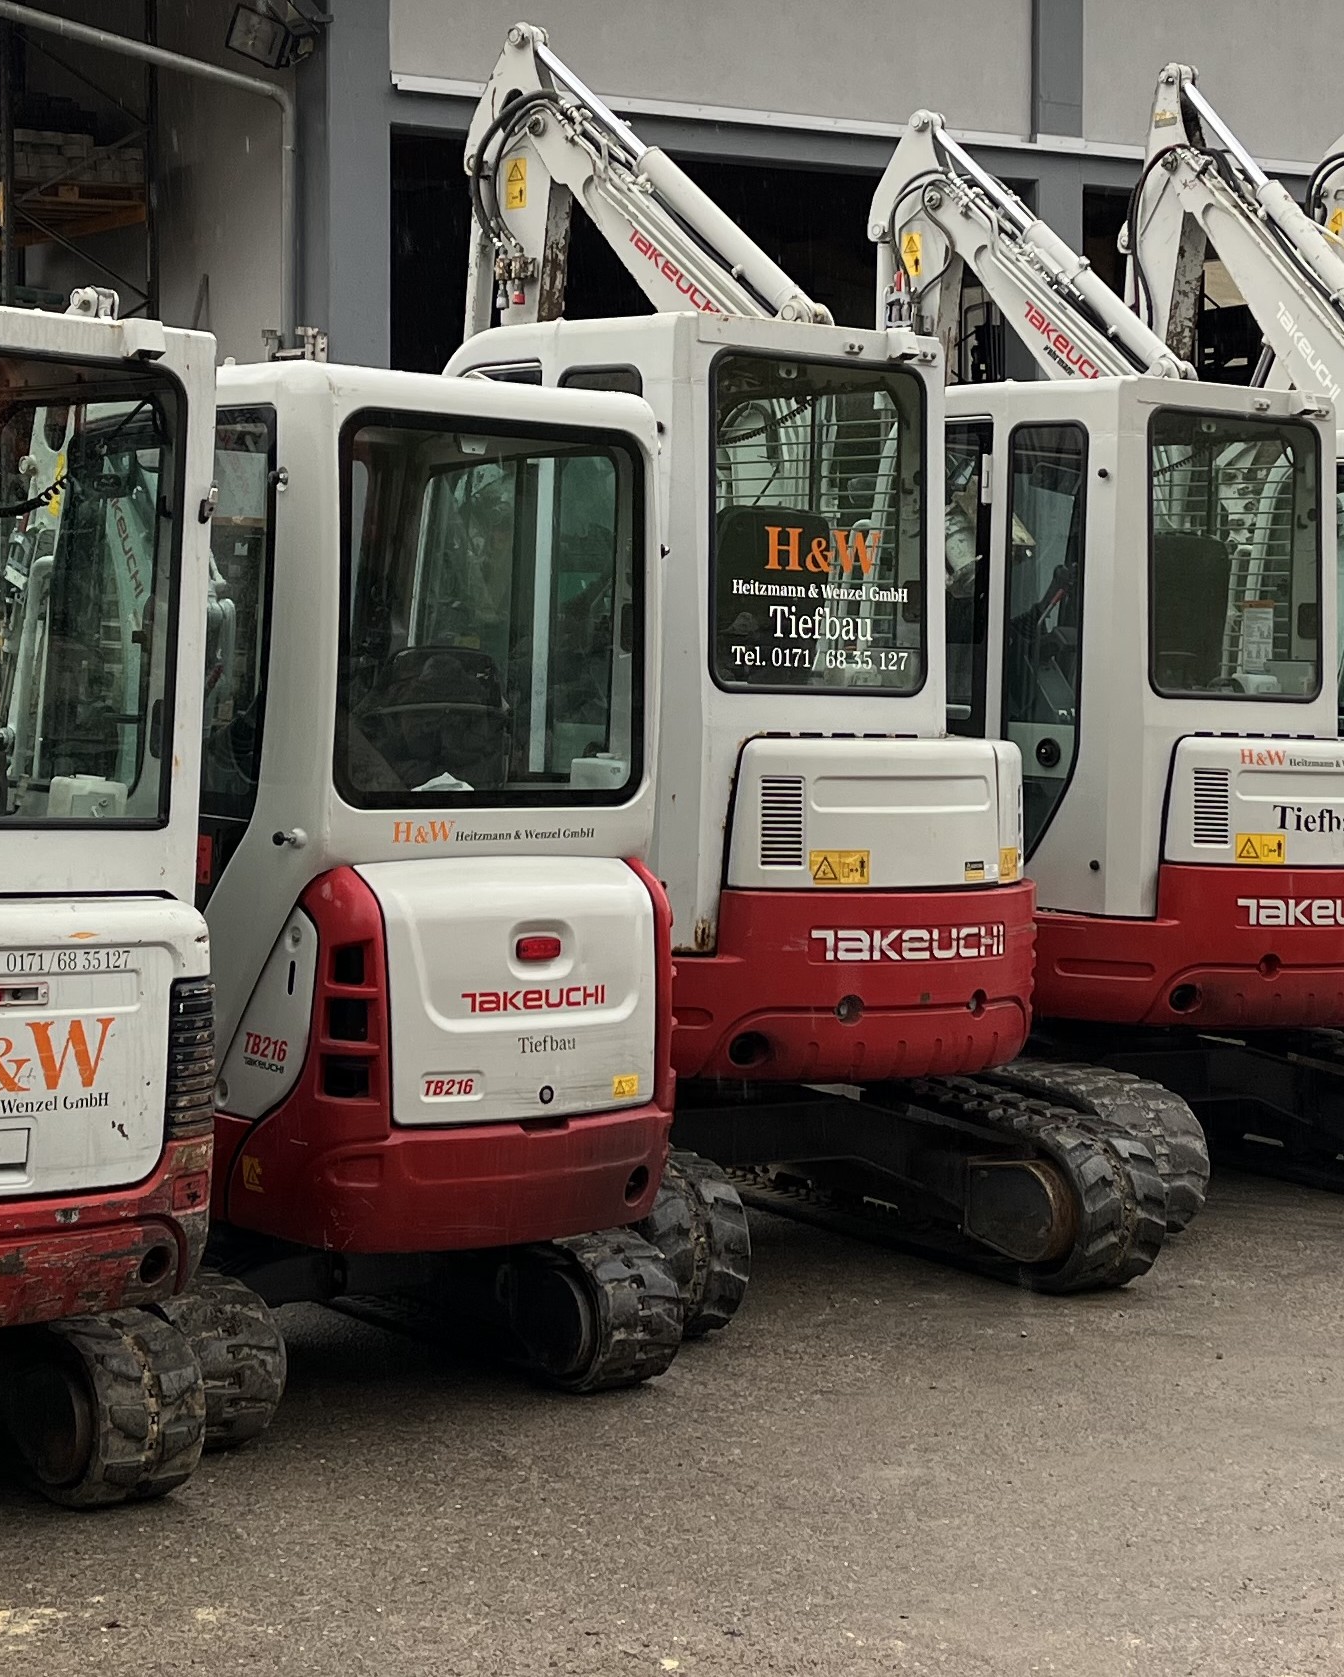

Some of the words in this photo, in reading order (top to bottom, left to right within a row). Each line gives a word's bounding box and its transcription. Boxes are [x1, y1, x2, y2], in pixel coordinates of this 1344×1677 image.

[764, 526, 881, 576] H&W
[732, 579, 806, 598] Heitzmann
[808, 583, 818, 598] &
[821, 584, 866, 600] Wenzel
[869, 587, 908, 602] GmbH
[770, 605, 873, 641] Tiefbau
[731, 646, 766, 666] Tel.
[772, 648, 820, 671] 0171/
[826, 650, 846, 669] 68
[852, 651, 872, 670] 35
[879, 652, 908, 671] 127
[1240, 749, 1287, 766] H&W
[1289, 758, 1334, 768] Heitzmann
[1335, 759, 1341, 768] &
[393, 820, 455, 844] H&W
[456, 830, 511, 842] Heitzmann
[514, 830, 522, 841] &
[525, 828, 562, 840] Wenzel
[563, 828, 595, 839] GmbH
[106, 950, 131, 969] 127
[244, 1032, 288, 1062] TB216
[518, 1035, 576, 1054] Tiefbau
[424, 1079, 474, 1097] TB216
[1, 1096, 58, 1114] Wenzel
[63, 1092, 110, 1109] GmbH
